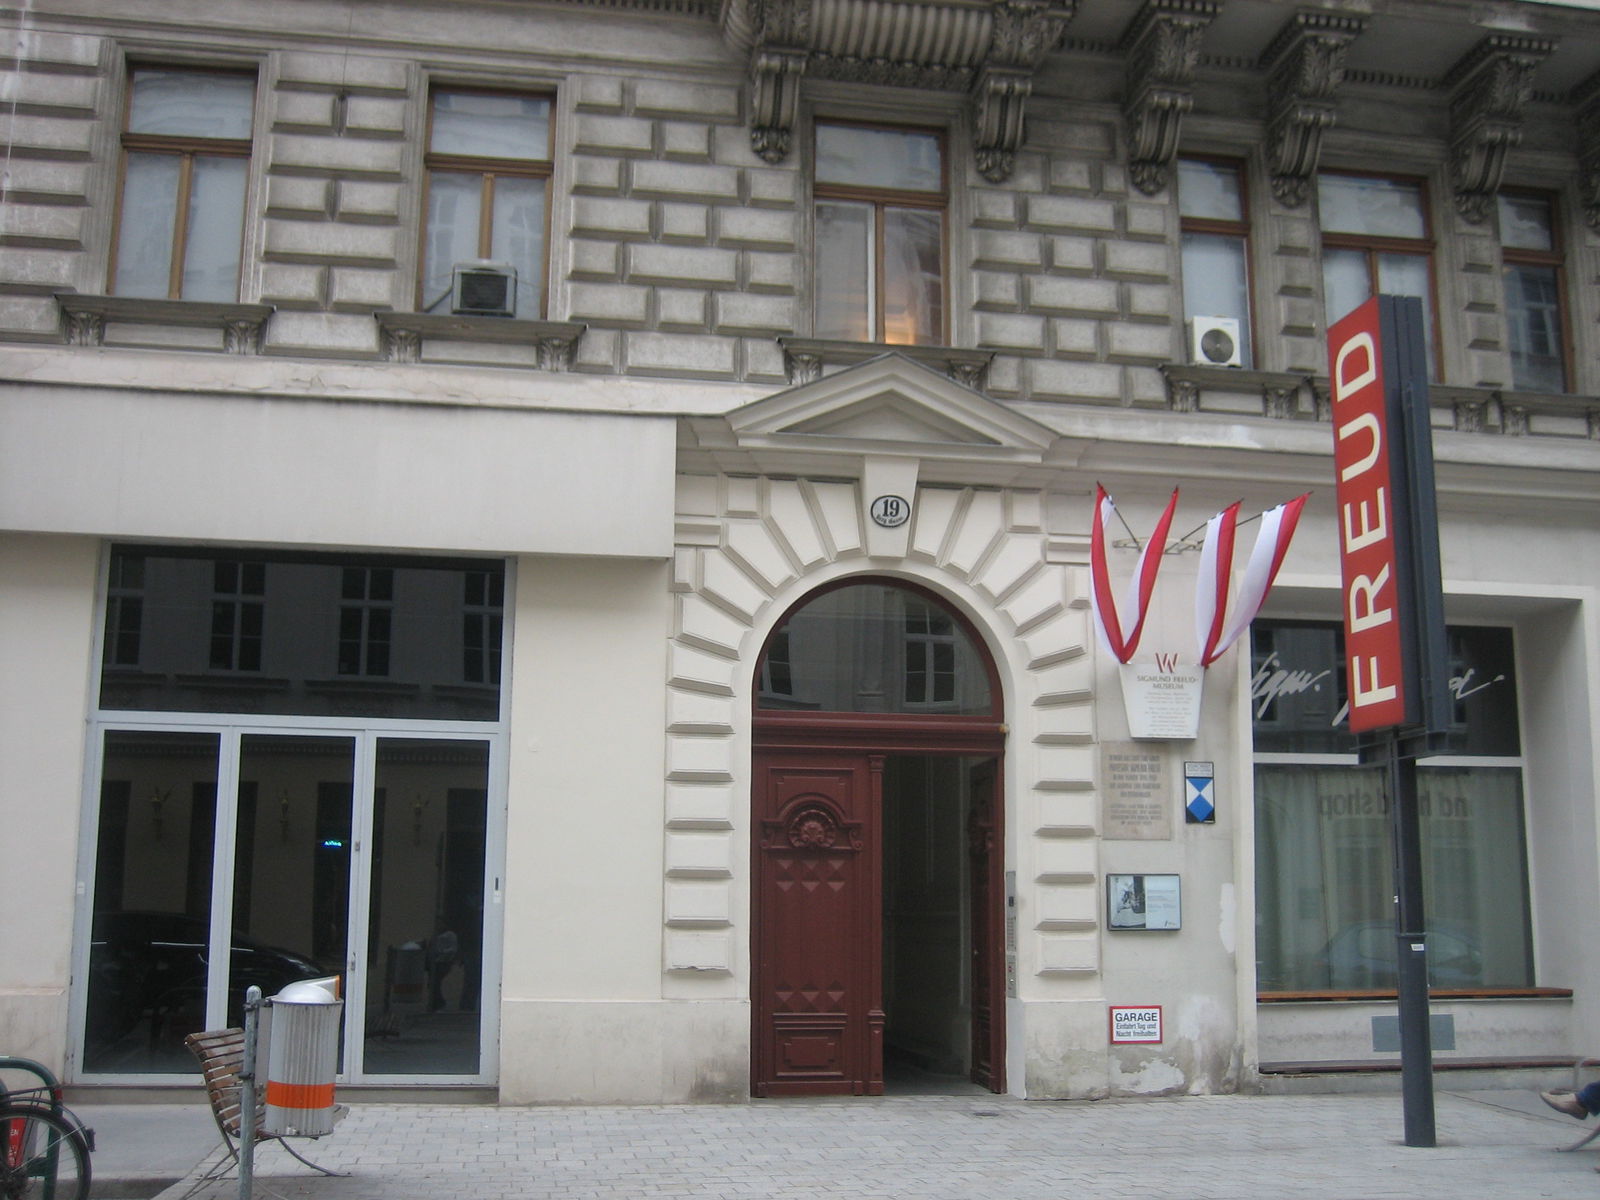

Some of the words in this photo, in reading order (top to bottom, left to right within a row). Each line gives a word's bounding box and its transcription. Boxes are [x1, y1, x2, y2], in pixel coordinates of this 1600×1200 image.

[883, 499, 900, 517] 19
[1334, 331, 1397, 708] FREUD
[1136, 675, 1172, 683] SIGMUND
[1115, 1012, 1158, 1021] GARAGE
